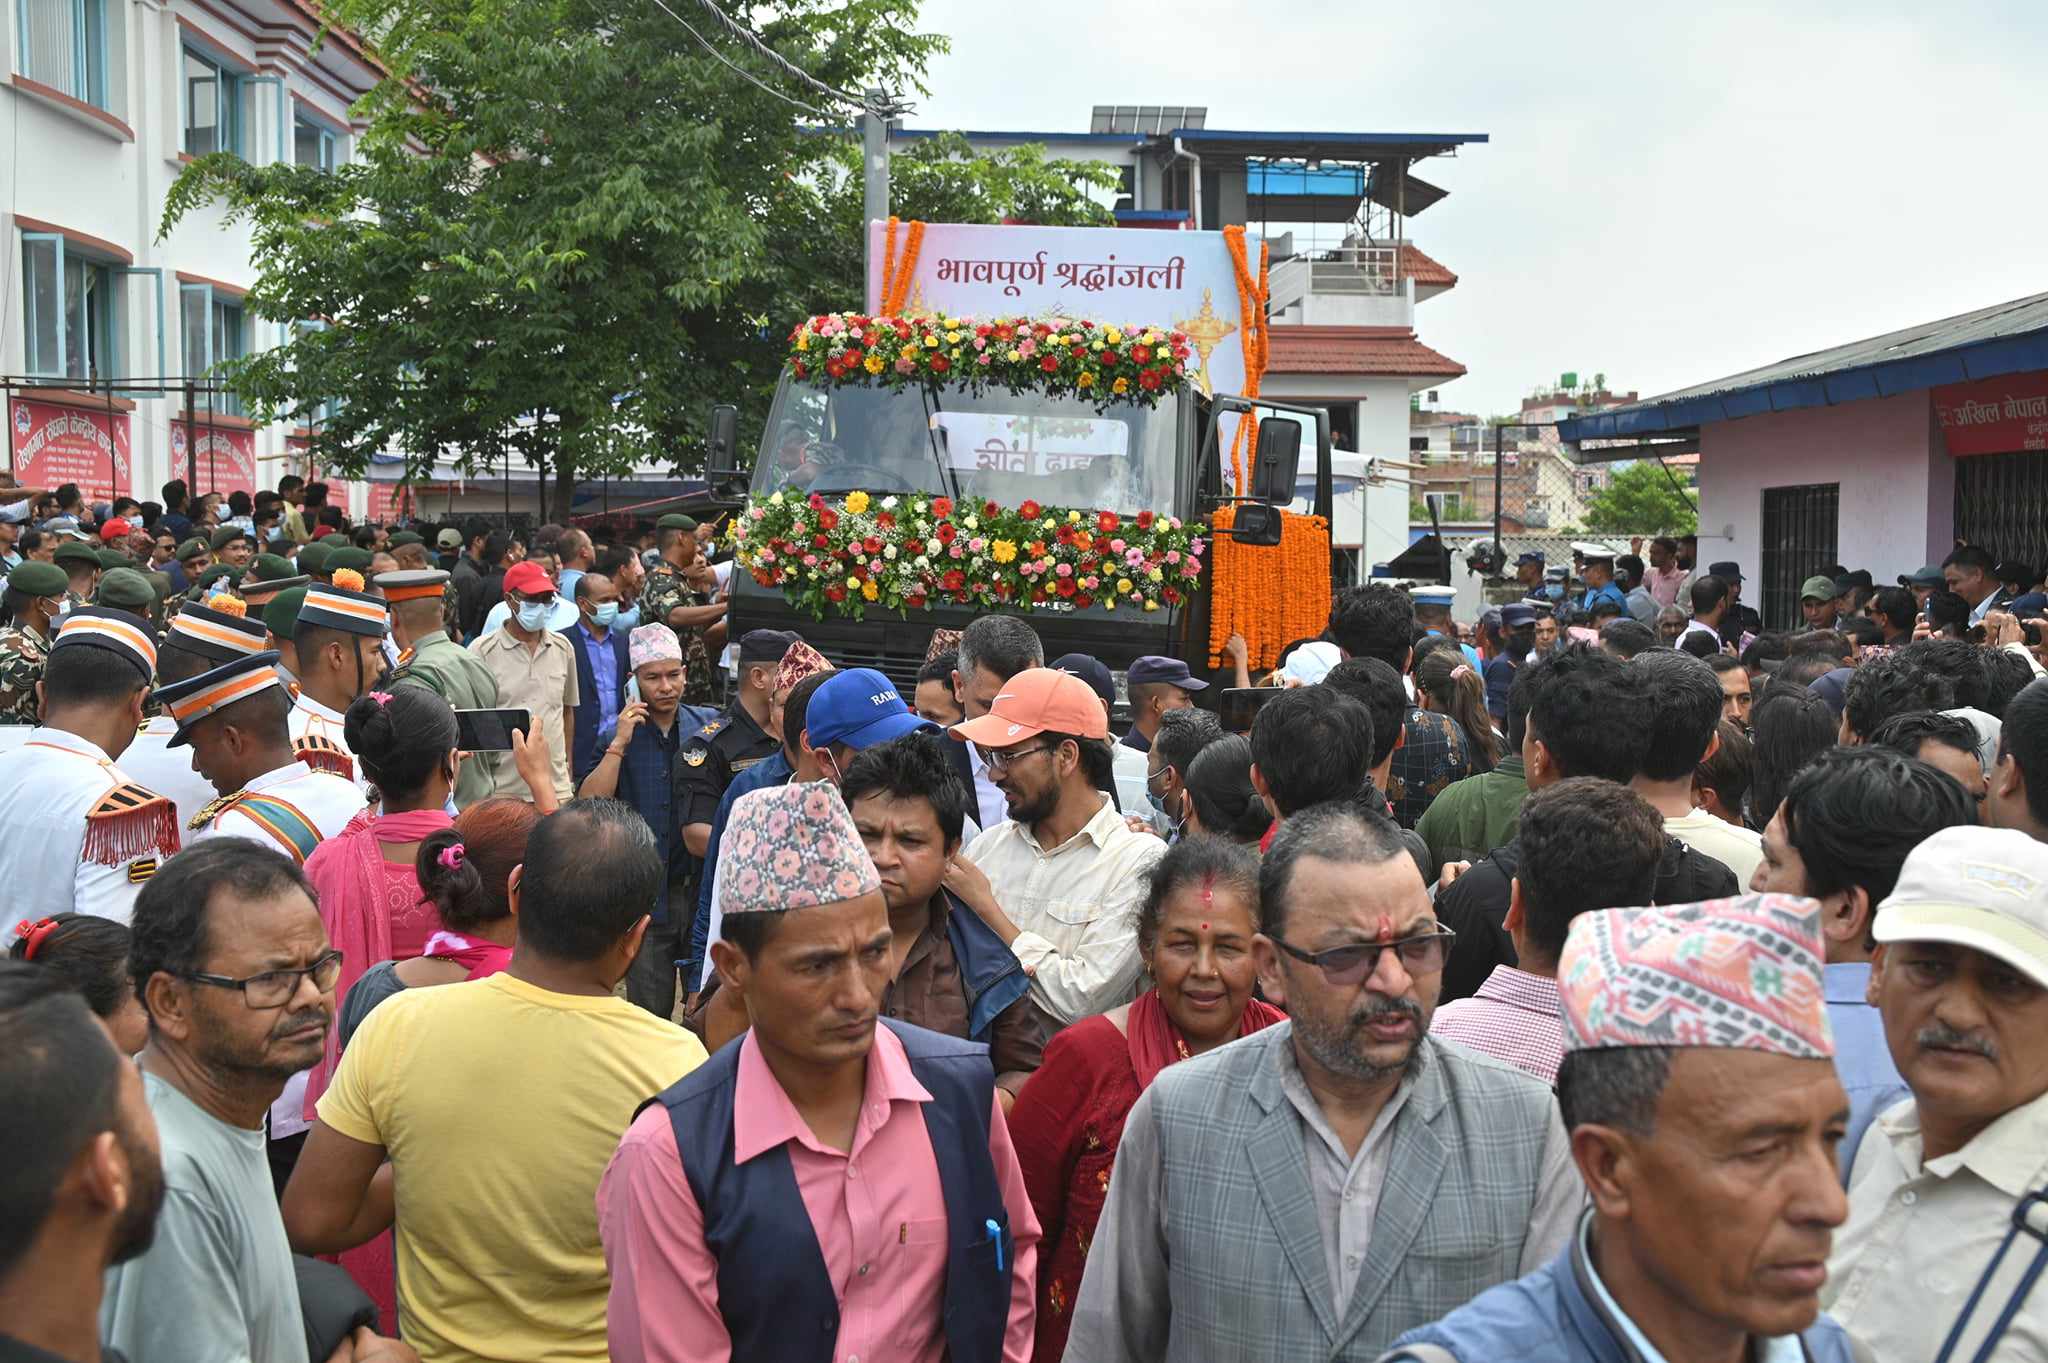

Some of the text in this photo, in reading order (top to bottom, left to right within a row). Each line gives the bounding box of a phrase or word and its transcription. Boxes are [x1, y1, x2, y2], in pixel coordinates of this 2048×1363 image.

[937, 250, 1187, 297] भावपूर्ण श्रद्धांजली
[1952, 399, 2001, 427] अखिल
[2003, 393, 2048, 420] नेपाल
